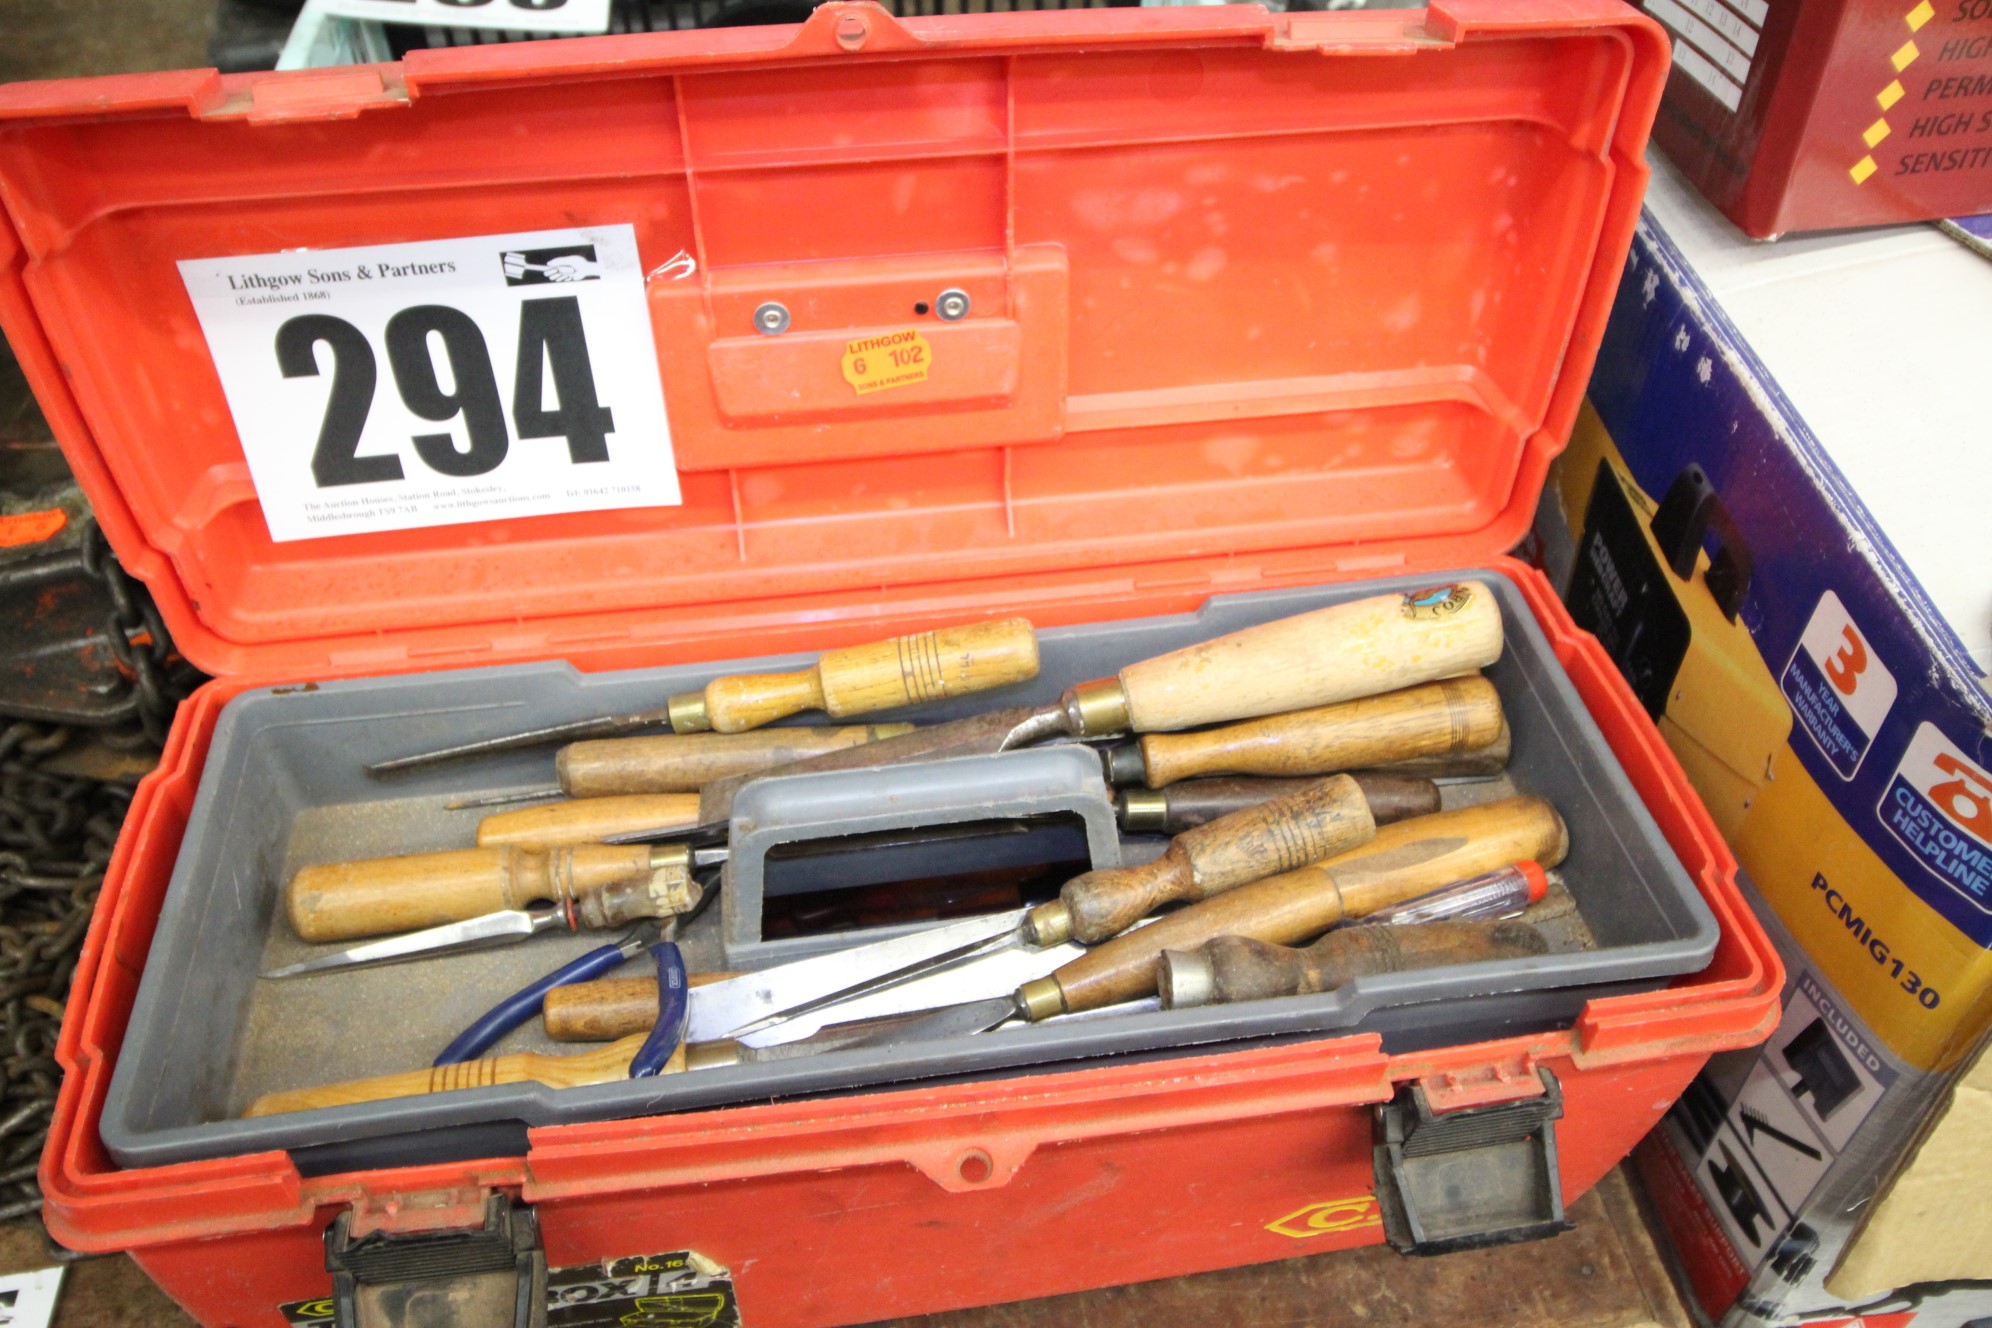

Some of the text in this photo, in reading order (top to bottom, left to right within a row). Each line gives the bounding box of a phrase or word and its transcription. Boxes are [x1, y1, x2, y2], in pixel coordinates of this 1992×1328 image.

[1952, 0, 1992, 22] SO
[1908, 112, 1976, 139] HIGH
[227, 259, 457, 291] Lithgow Sons & Partners
[235, 290, 331, 308] (Established 1868)
[849, 331, 916, 354] LITHGOW
[888, 345, 925, 368] 102
[274, 296, 617, 489] 294
[1824, 623, 1868, 696] 3
[1789, 662, 1861, 763] MANUFACTURER'S
[1794, 693, 1840, 758] WARRANTY
[1817, 681, 1841, 717] YEAR
[1892, 808, 1991, 897] HELPLINE
[1895, 787, 1992, 879] CUSTOME
[1810, 871, 1941, 1011] PCMIG130
[1802, 978, 1882, 1073] INCLUDED
